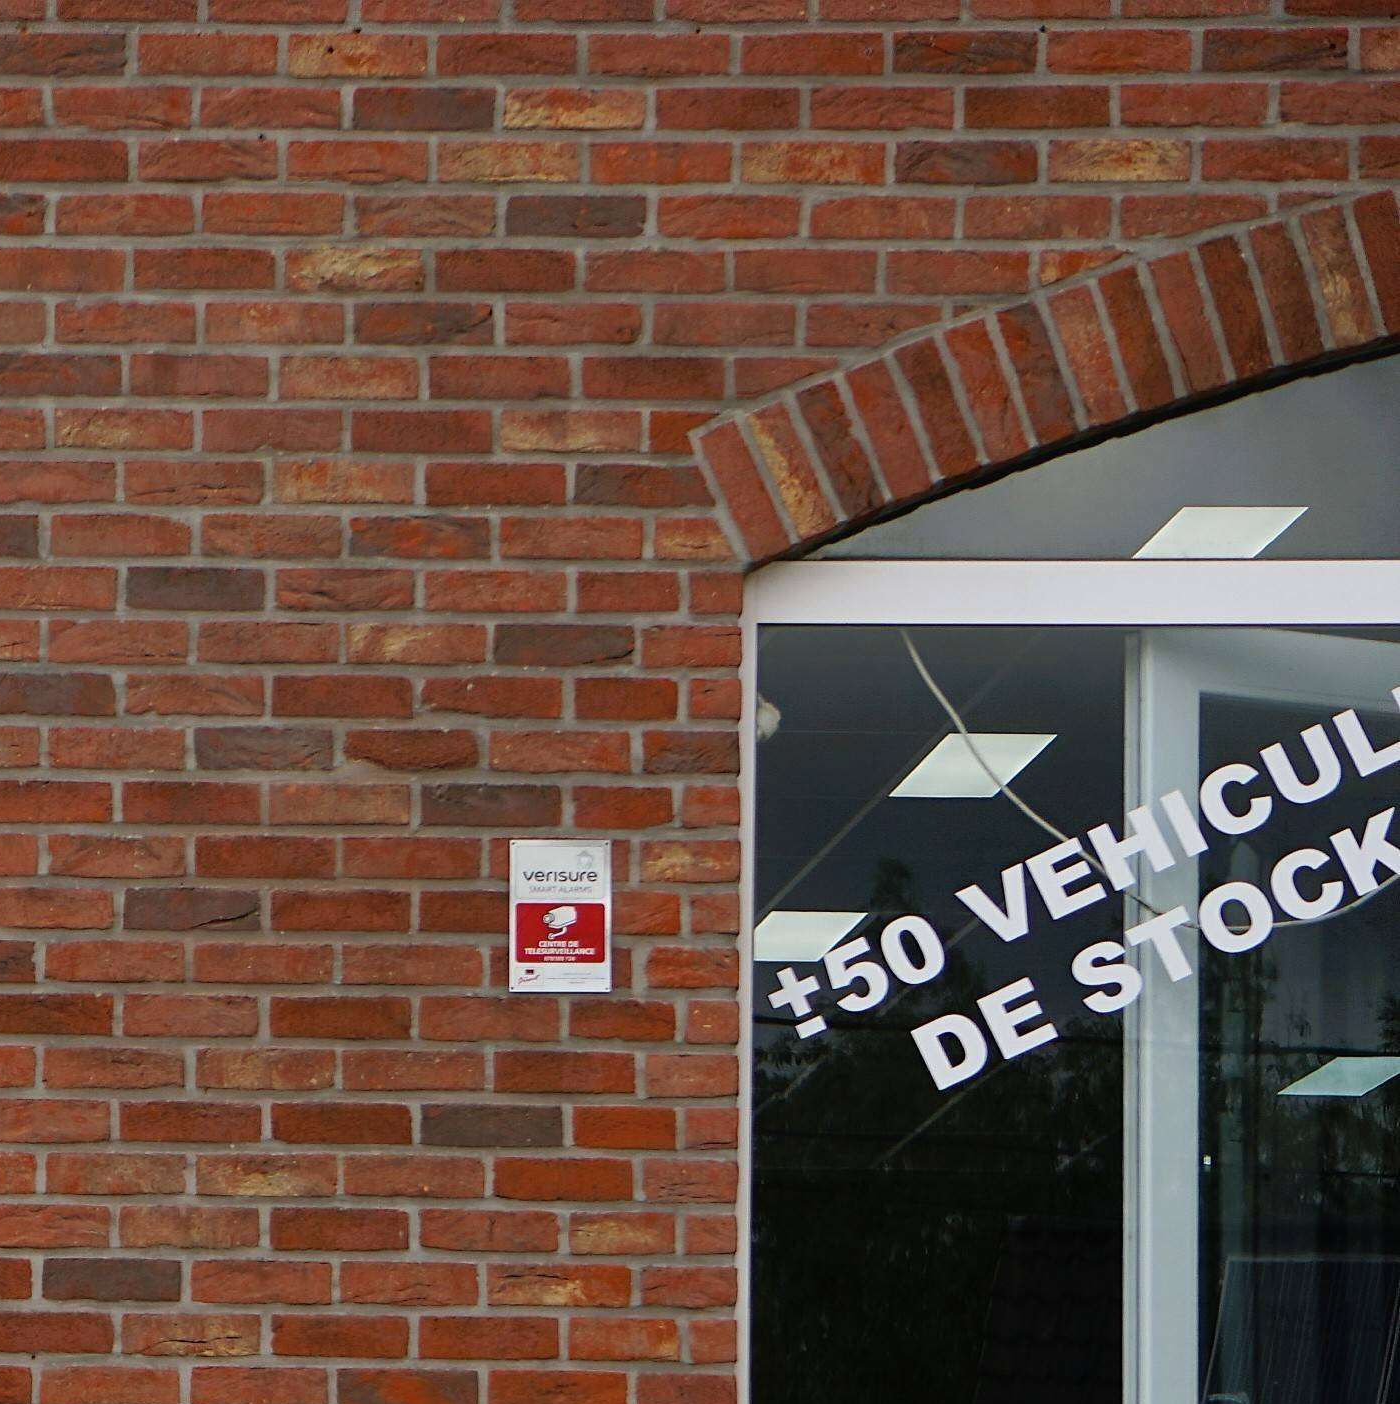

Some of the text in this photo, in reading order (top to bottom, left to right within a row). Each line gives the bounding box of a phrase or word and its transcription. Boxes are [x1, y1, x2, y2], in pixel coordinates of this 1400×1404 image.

[522, 870, 598, 882] verisure
[955, 687, 1400, 942] VEHICUL
[910, 807, 1400, 1091] DE STOCK
